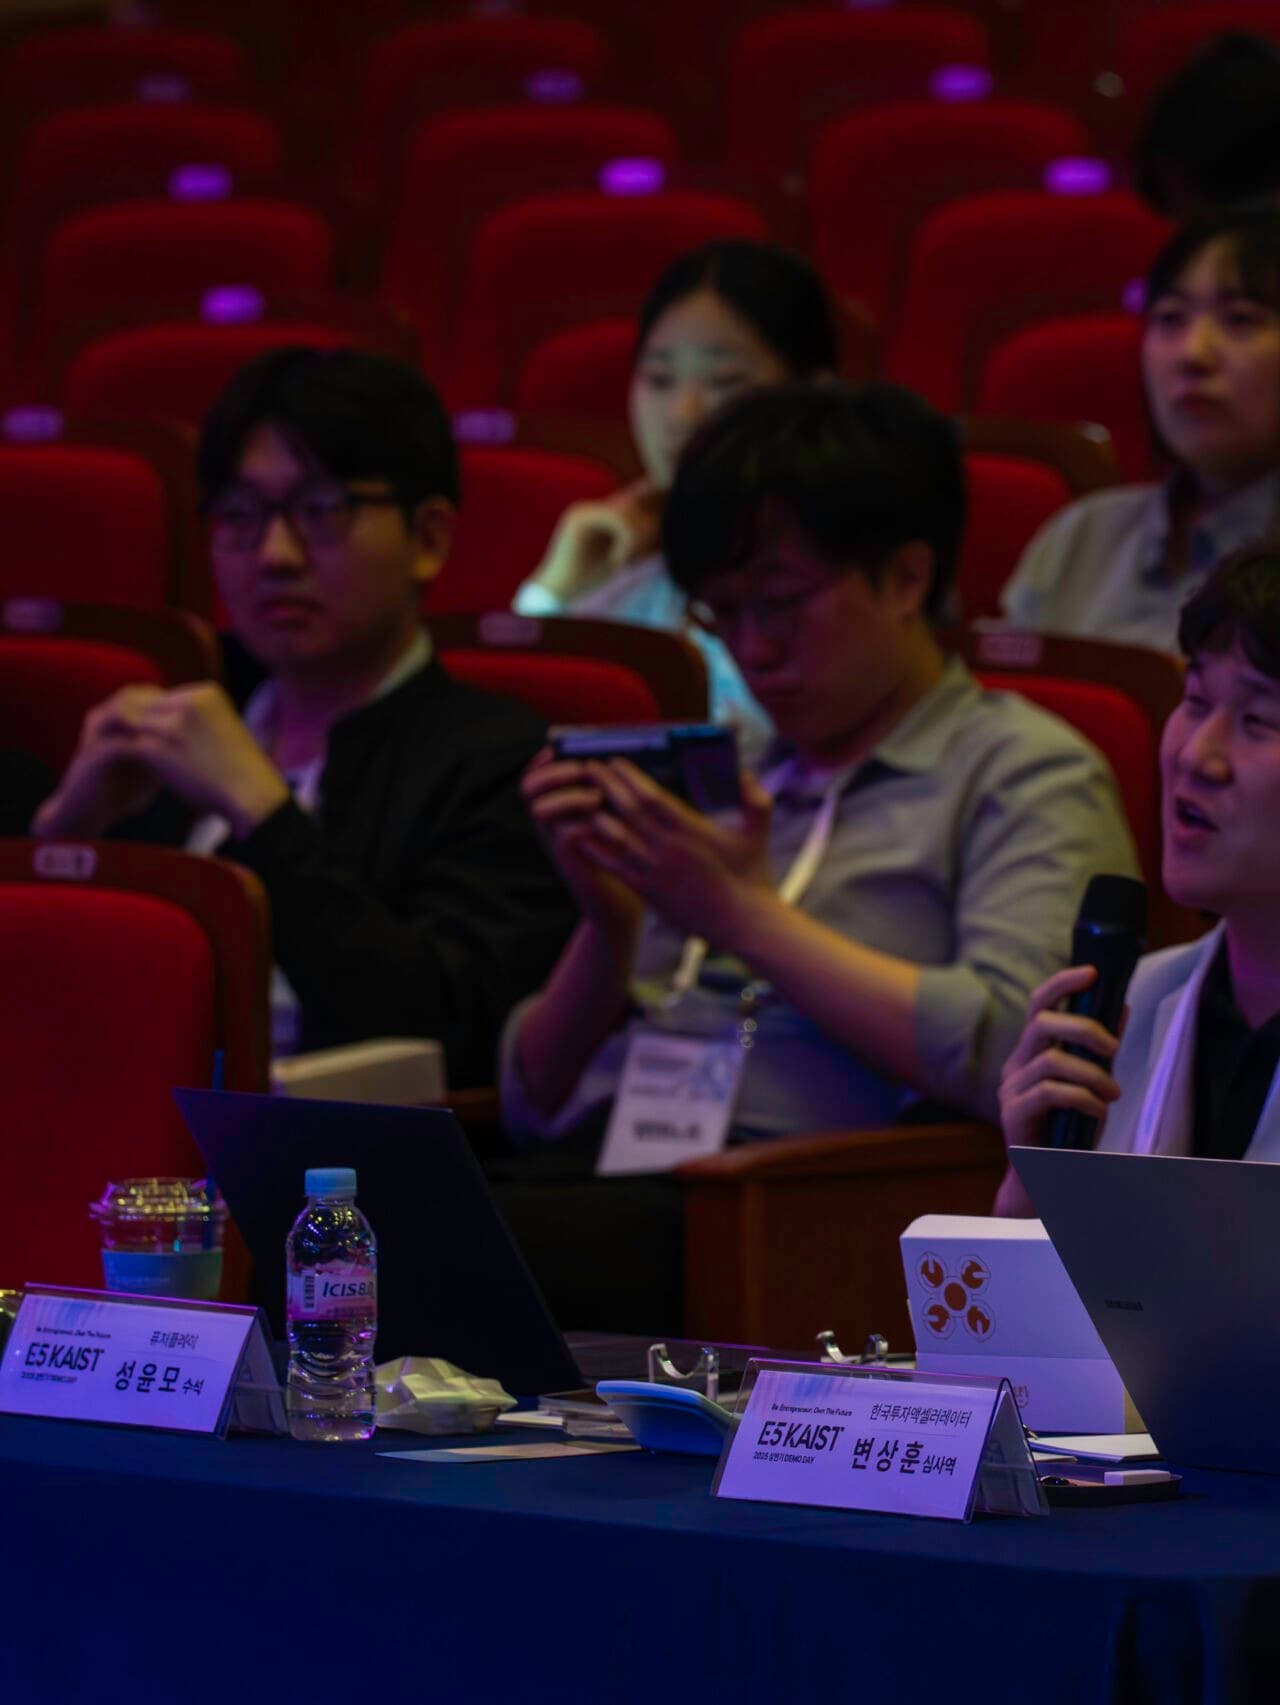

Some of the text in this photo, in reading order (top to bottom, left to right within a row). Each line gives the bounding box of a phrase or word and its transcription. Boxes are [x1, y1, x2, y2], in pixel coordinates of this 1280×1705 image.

[115, 1361, 205, 1395] 성윤모 수석
[870, 1403, 972, 1428] 한국투자액셀러레이터
[852, 1437, 957, 1476] 변상훈 심사역
